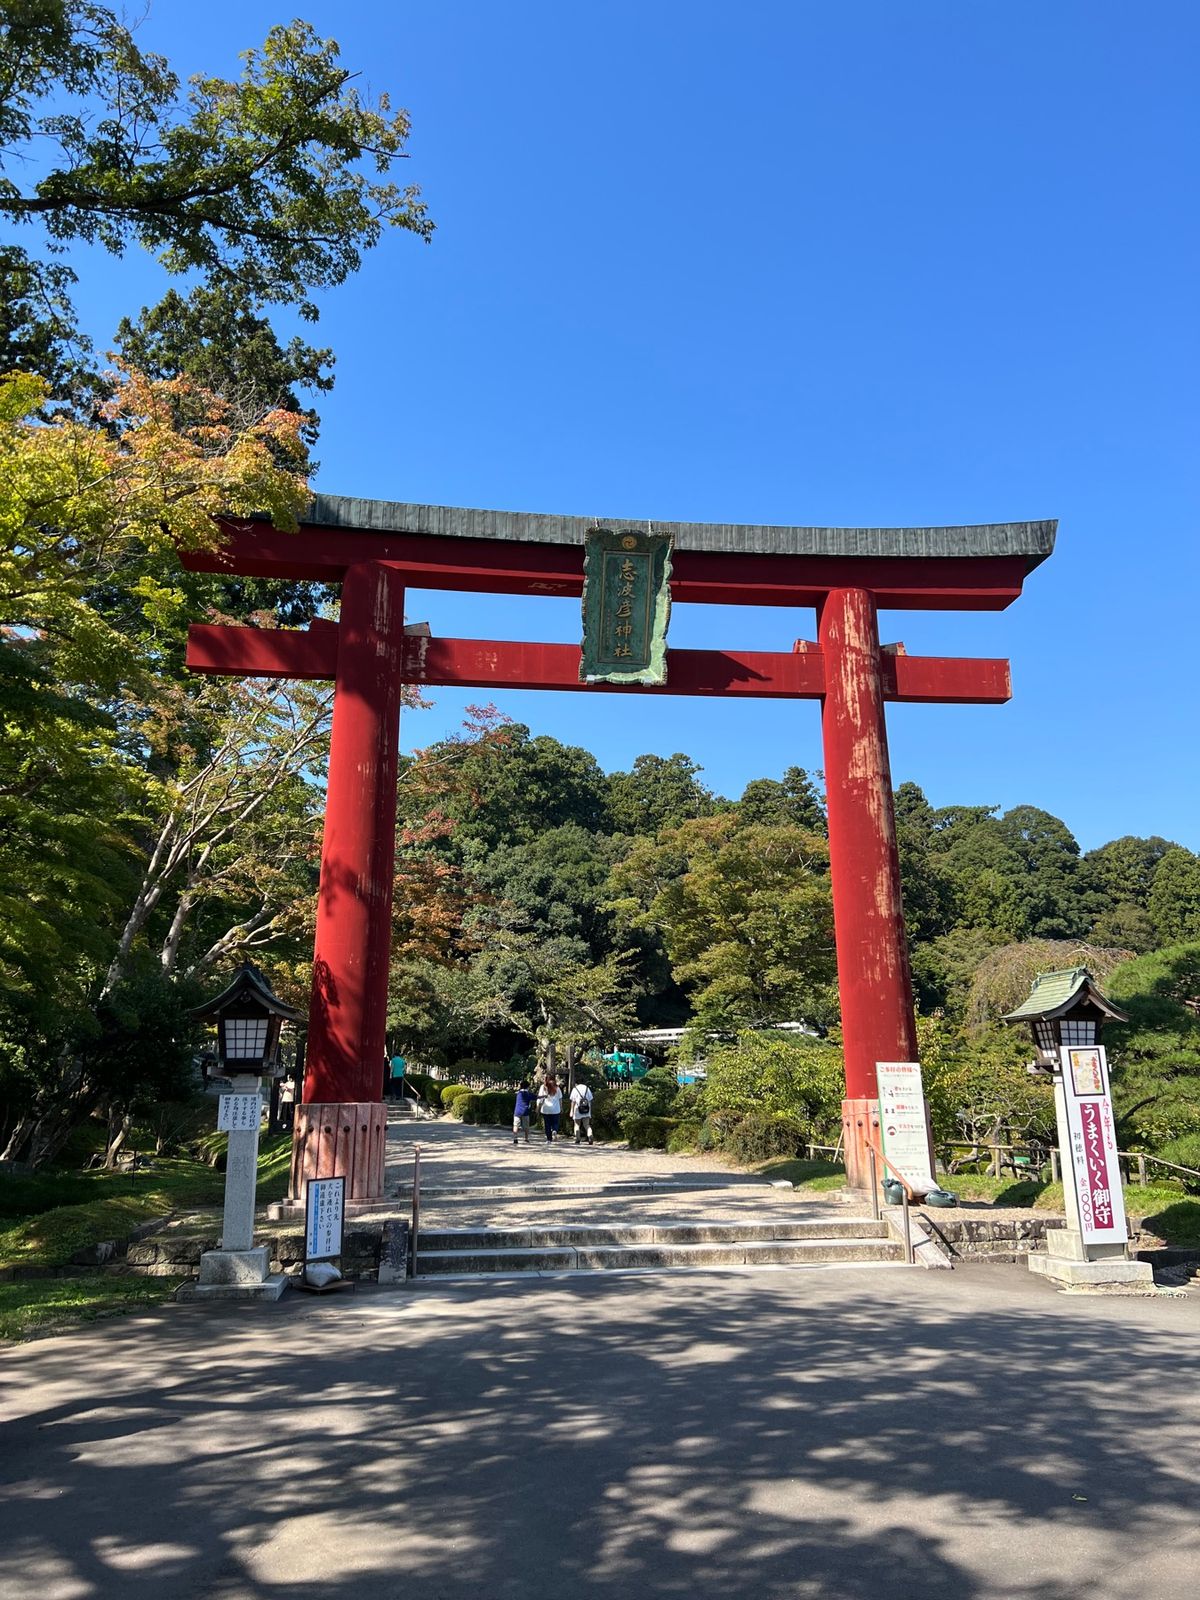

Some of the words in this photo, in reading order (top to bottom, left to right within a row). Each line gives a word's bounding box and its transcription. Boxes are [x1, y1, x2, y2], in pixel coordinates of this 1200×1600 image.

[613, 558, 638, 657] 志波彦神社
[1073, 1132, 1084, 1165] 初穂料
[1102, 1097, 1114, 1150] 今年も
[1084, 1103, 1111, 1225] うまくいく御守
